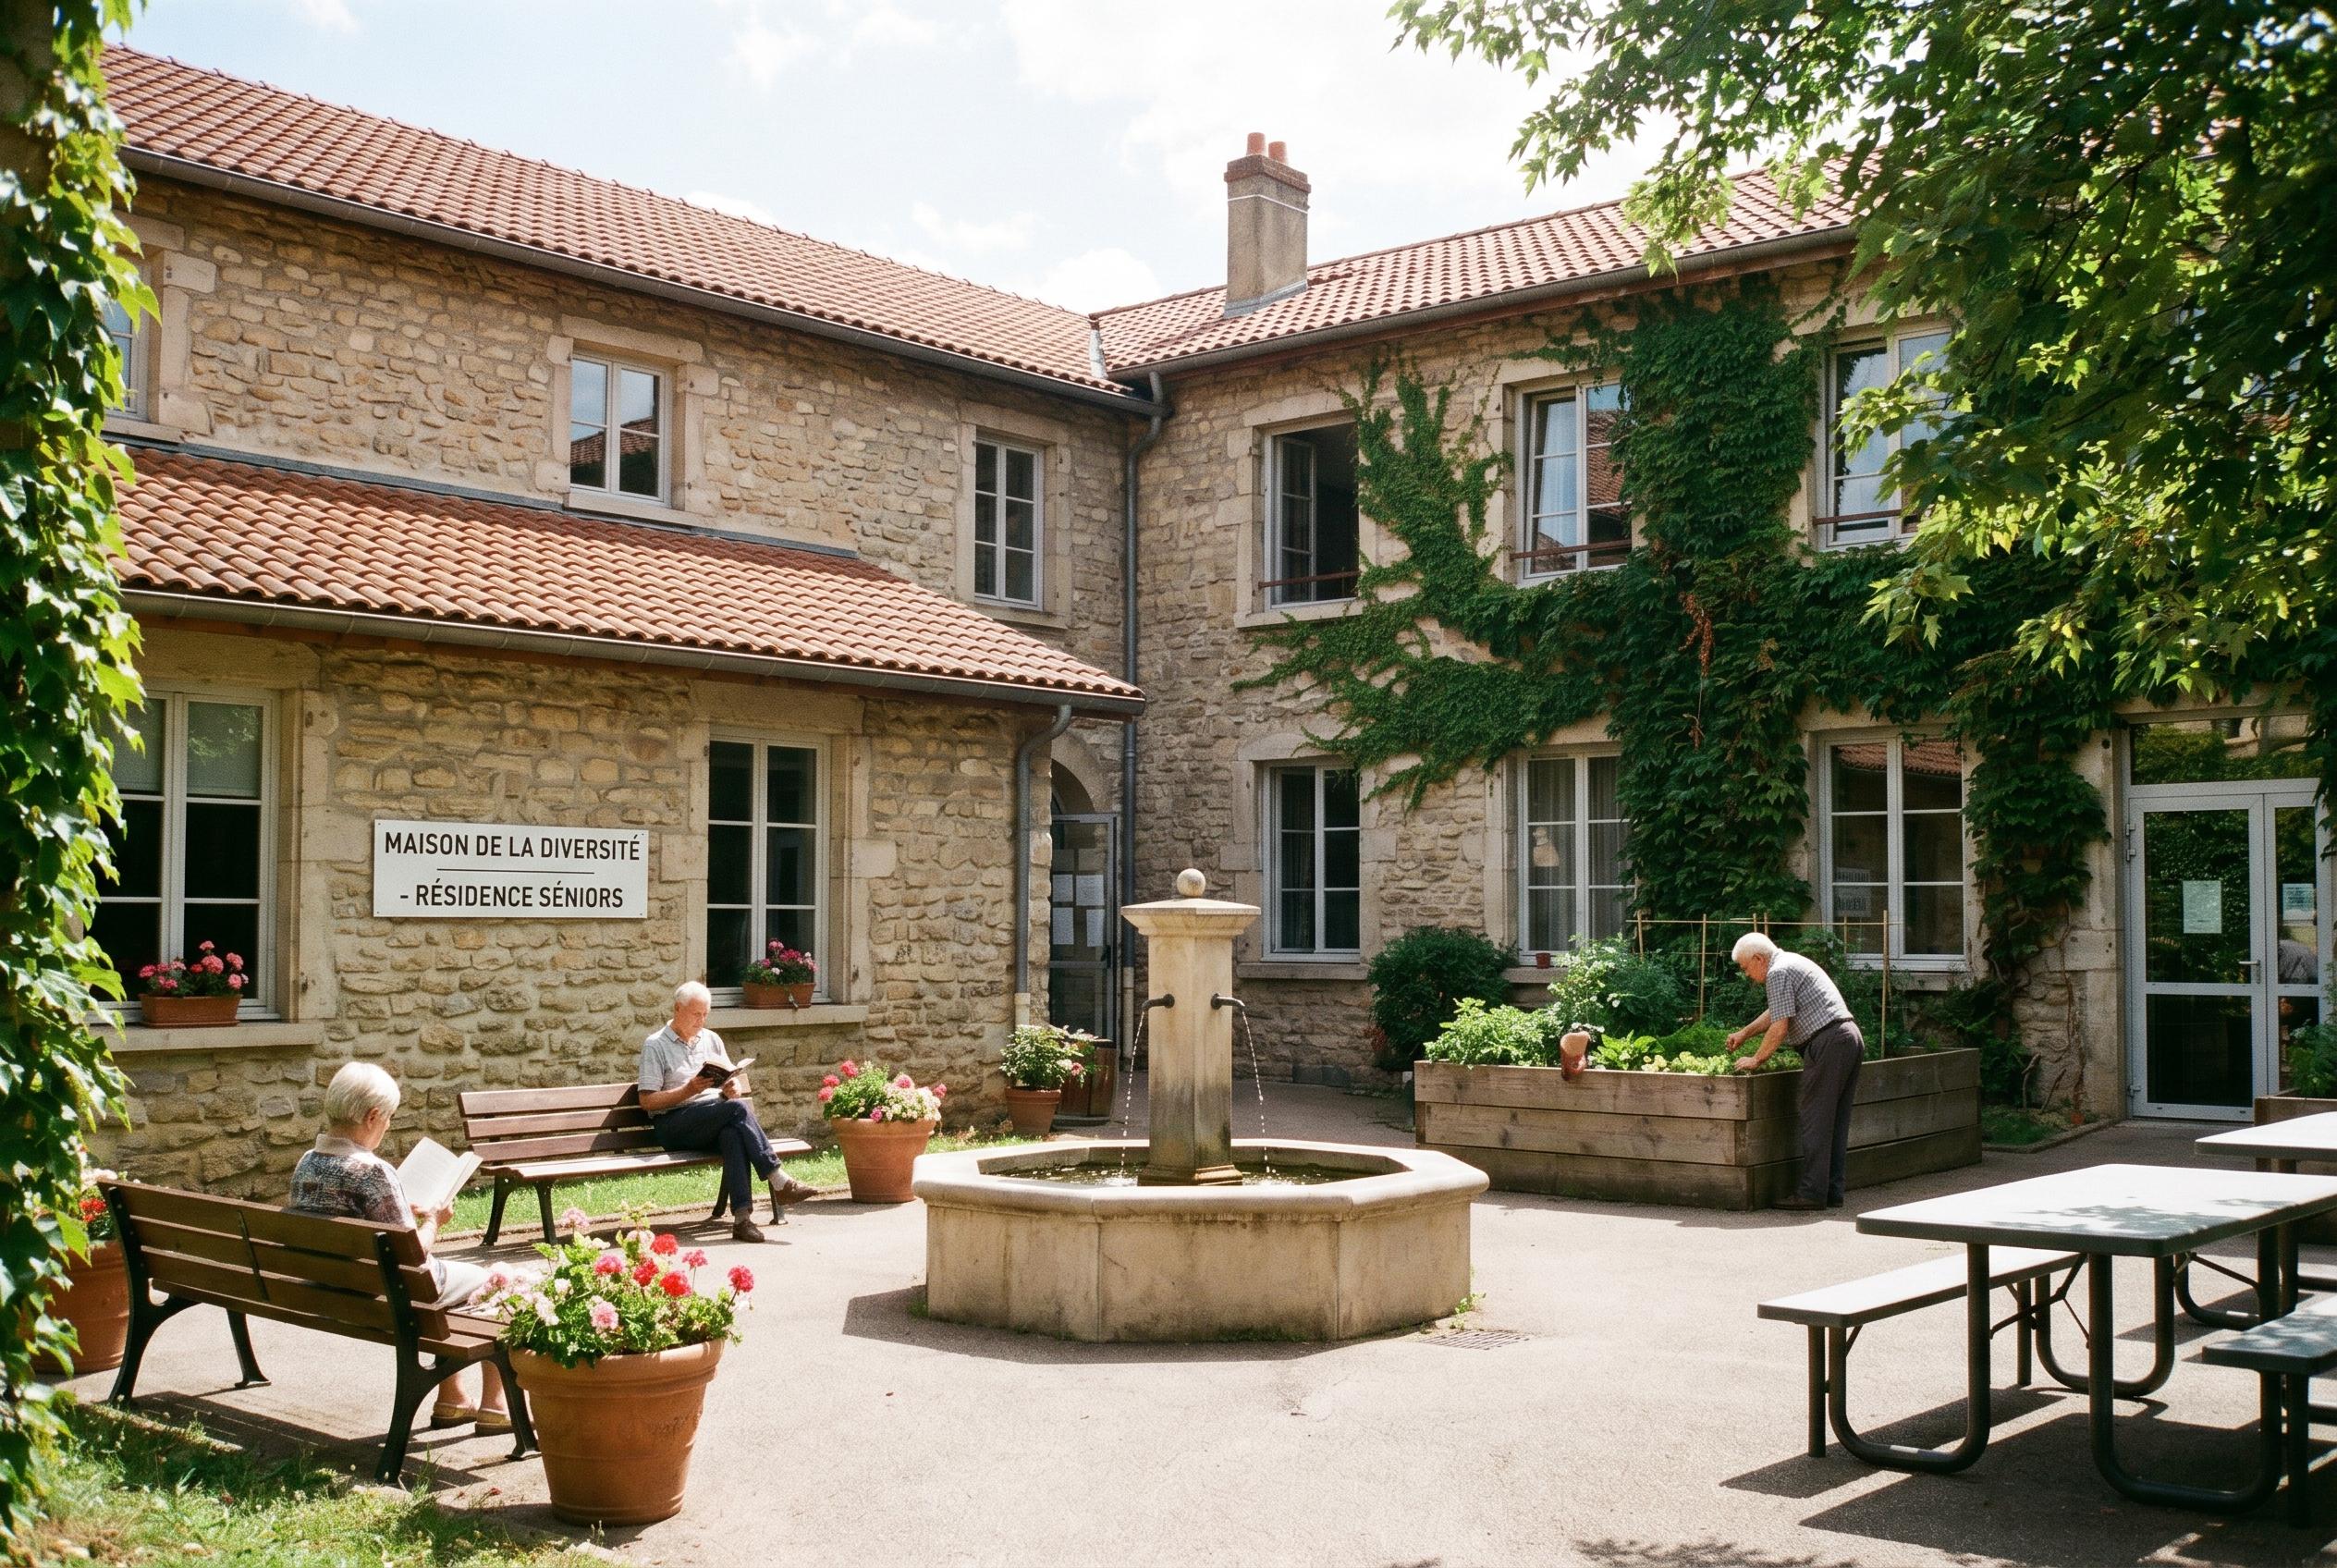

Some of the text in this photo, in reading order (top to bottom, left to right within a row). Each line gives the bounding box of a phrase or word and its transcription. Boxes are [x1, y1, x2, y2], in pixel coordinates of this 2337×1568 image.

[385, 831, 641, 861] MAISON DE LA DIVERSITÉ
[416, 878, 533, 908] RÉSIDENCE
[539, 880, 624, 908] SÉNIORS
